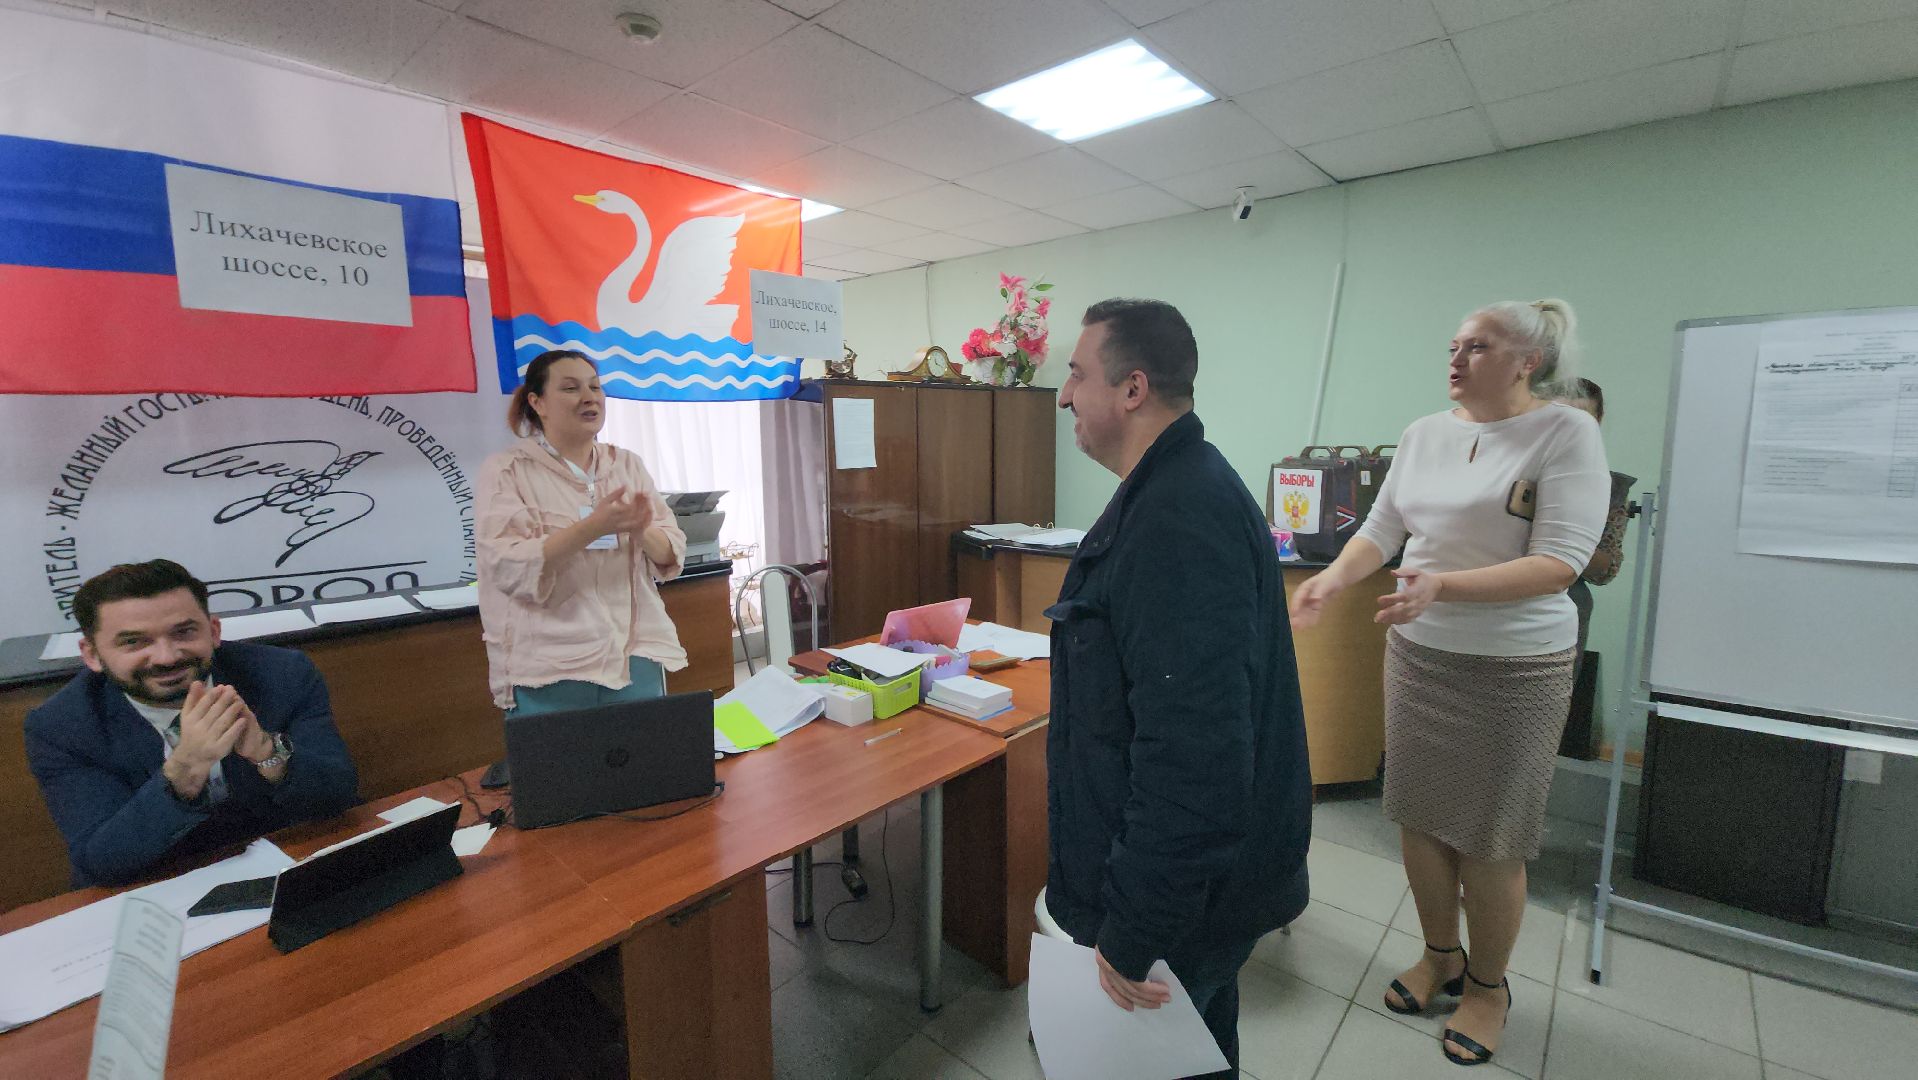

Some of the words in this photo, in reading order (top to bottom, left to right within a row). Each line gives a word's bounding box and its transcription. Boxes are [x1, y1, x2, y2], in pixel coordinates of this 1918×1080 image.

[190, 210, 388, 258] Лихачевское
[222, 255, 328, 286] шоссе,
[339, 265, 369, 286] 10
[769, 318, 810, 333] шоссе,
[815, 319, 827, 333] 14
[46, 415, 137, 520] ЖЕЛАННЫЙ
[1280, 473, 1315, 487] ВЫБОРЫ
